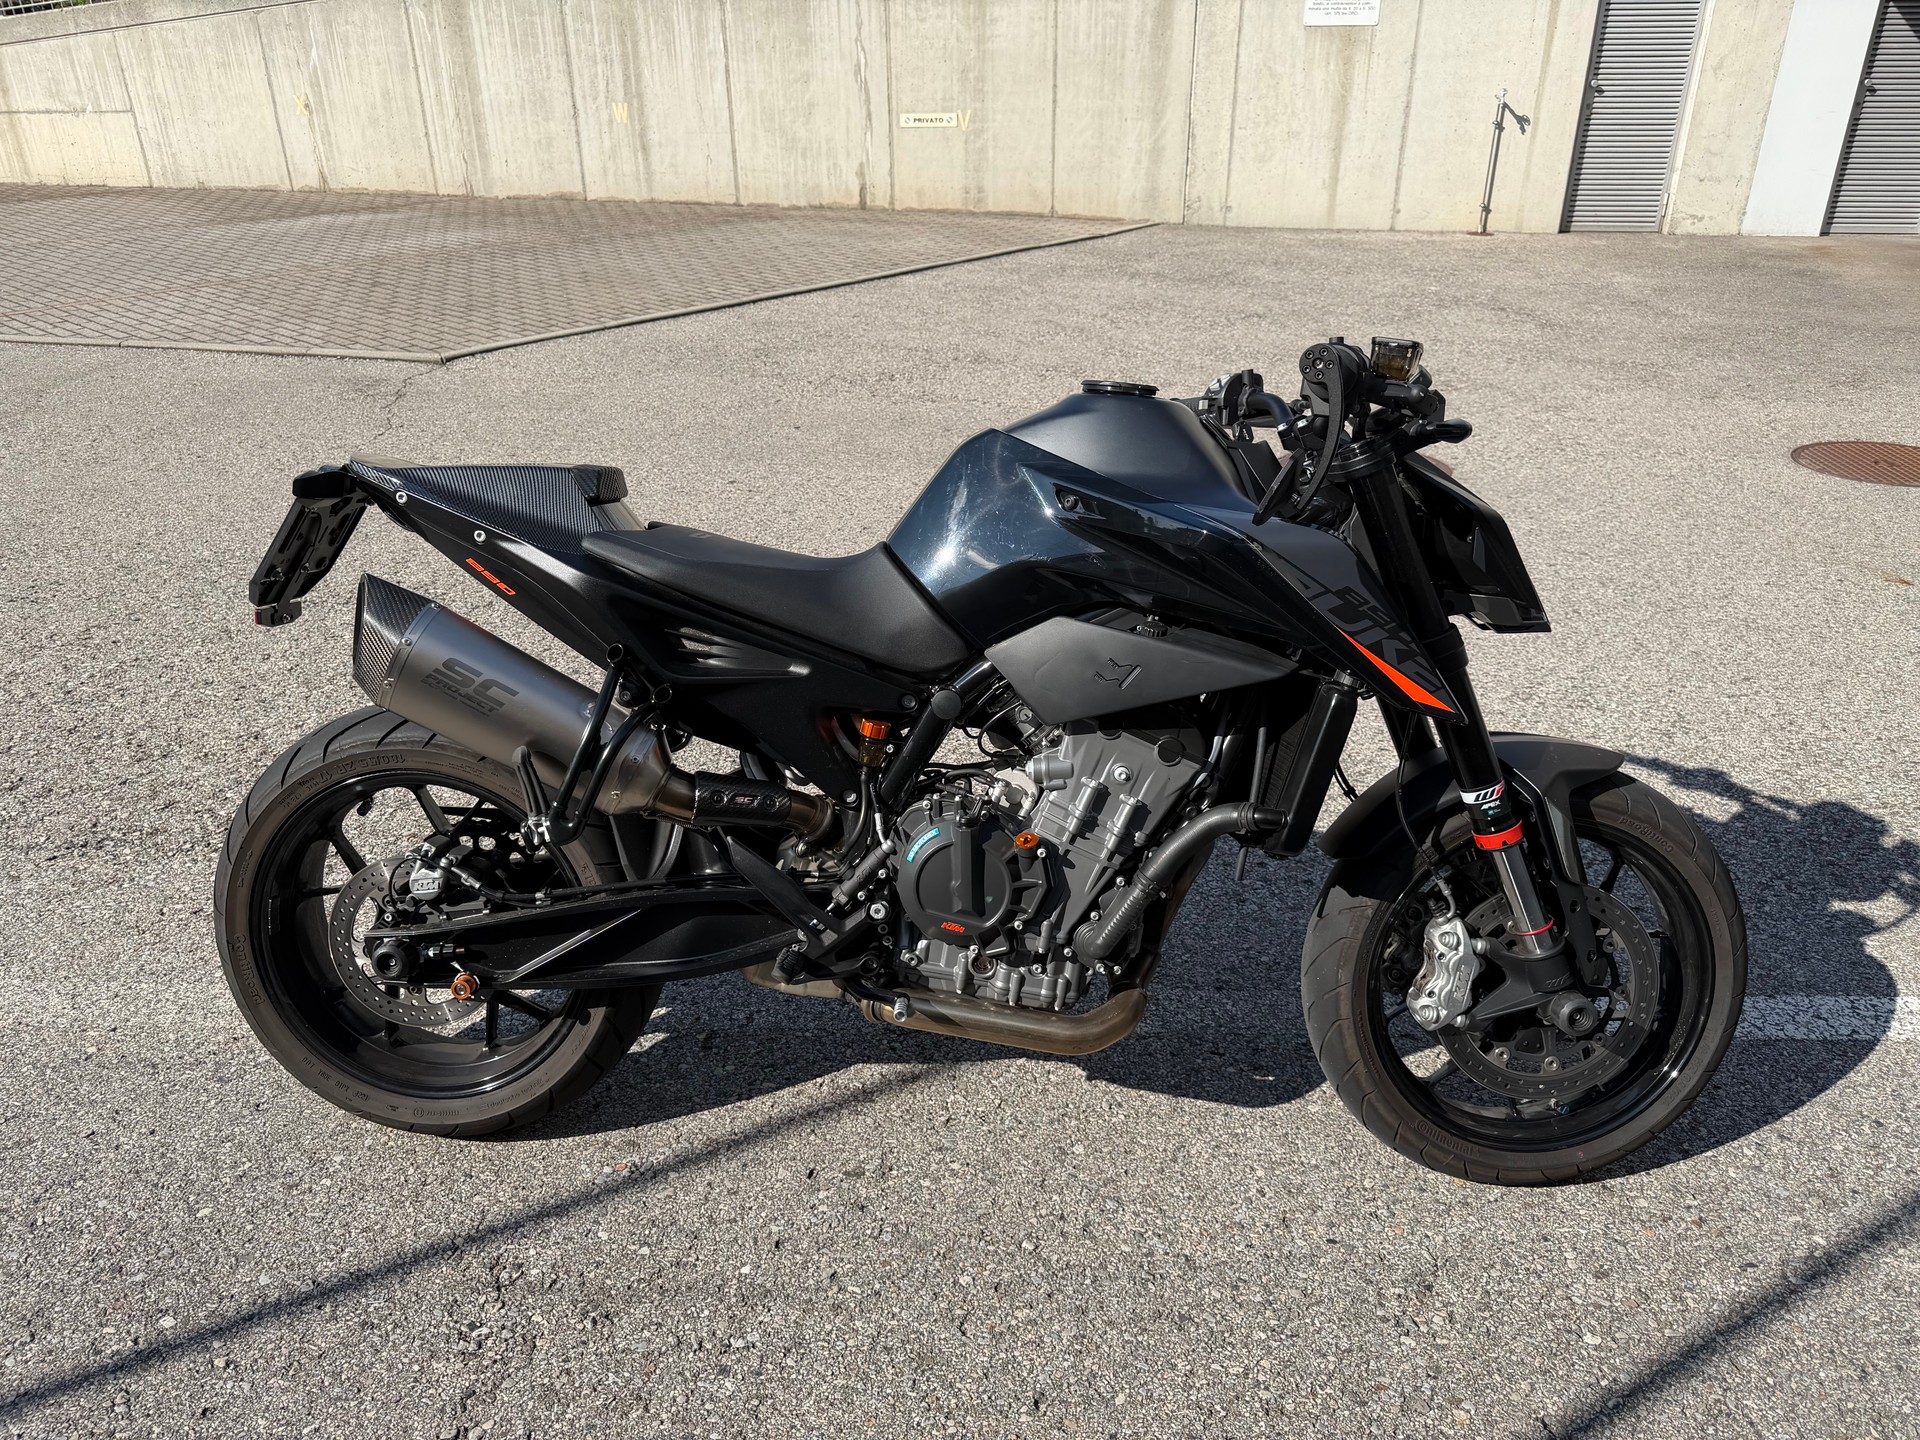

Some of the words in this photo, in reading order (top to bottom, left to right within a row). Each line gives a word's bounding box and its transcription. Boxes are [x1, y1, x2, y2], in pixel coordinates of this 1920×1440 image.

[612, 102, 628, 123] W
[421, 672, 500, 713] PROJECT
[431, 657, 520, 709] SC
[413, 879, 439, 891] KTM
[941, 921, 966, 934] KTM
